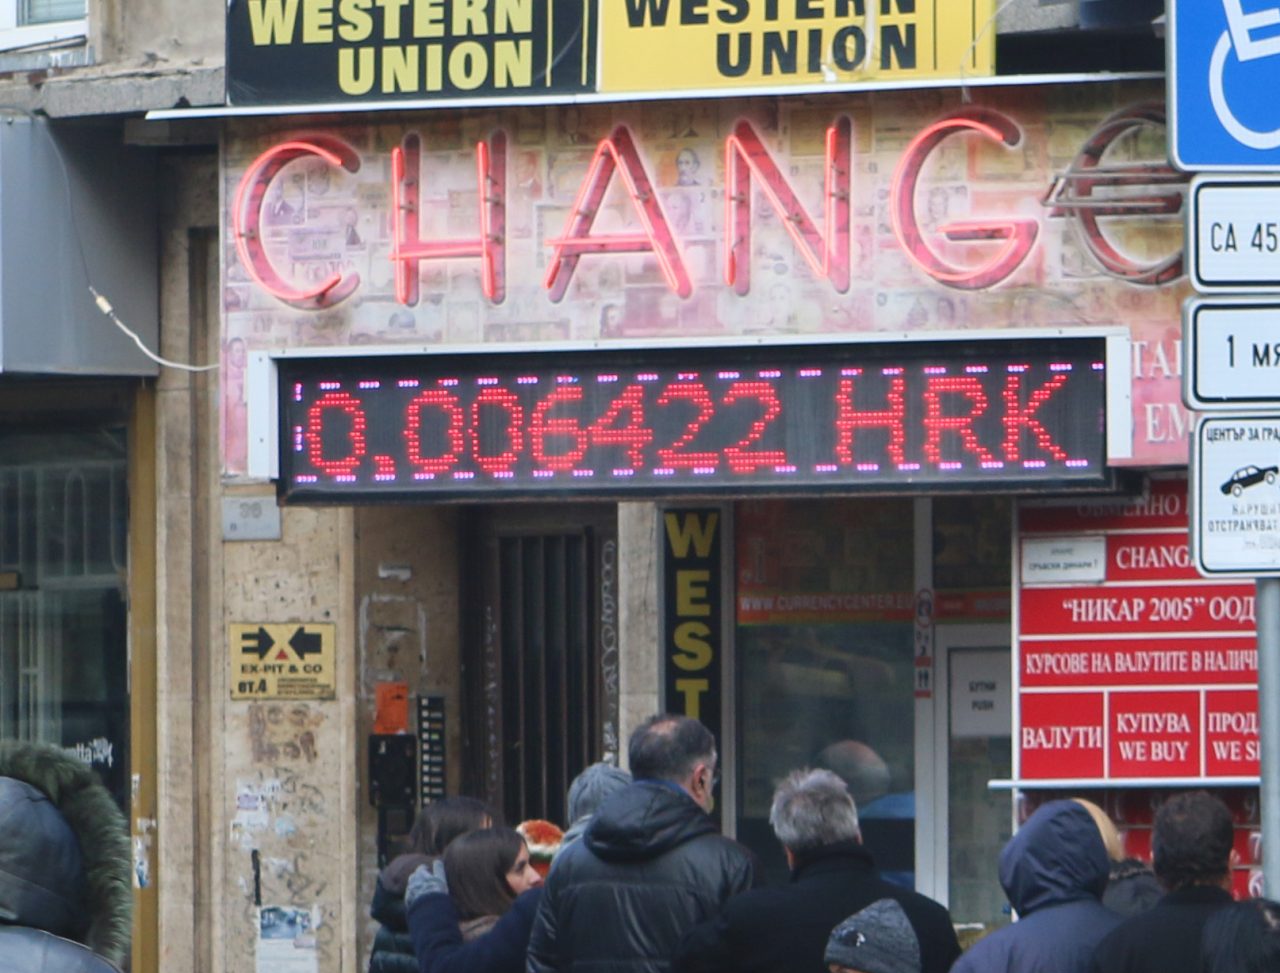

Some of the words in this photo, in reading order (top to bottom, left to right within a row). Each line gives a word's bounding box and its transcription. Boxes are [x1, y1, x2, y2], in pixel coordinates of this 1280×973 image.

[248, 0, 532, 46] WESTERN
[716, 23, 917, 77] UNION
[338, 39, 533, 96] UNION
[1211, 222, 1237, 252] CA
[1226, 334, 1235, 367] 1
[306, 380, 786, 475] 0.006422
[835, 368, 1073, 468] HRK
[1206, 427, 1246, 443] ЦЕНТЪР
[1248, 427, 1260, 441] ЗА
[1115, 545, 1196, 570] CHANG
[1208, 596, 1257, 624] ООД
[302, 663, 322, 674] CO
[1025, 651, 1087, 675] КУРСОВЕ
[1091, 651, 1112, 674] НА
[1114, 649, 1188, 674] ВАЛУТИТЕ
[1191, 649, 1201, 671] В
[1115, 712, 1191, 734] КУПУВА
[1022, 725, 1103, 750] ВАЛУТИ
[1119, 741, 1147, 762] WE
[1150, 740, 1190, 762] BUY
[1212, 740, 1241, 762] WE
